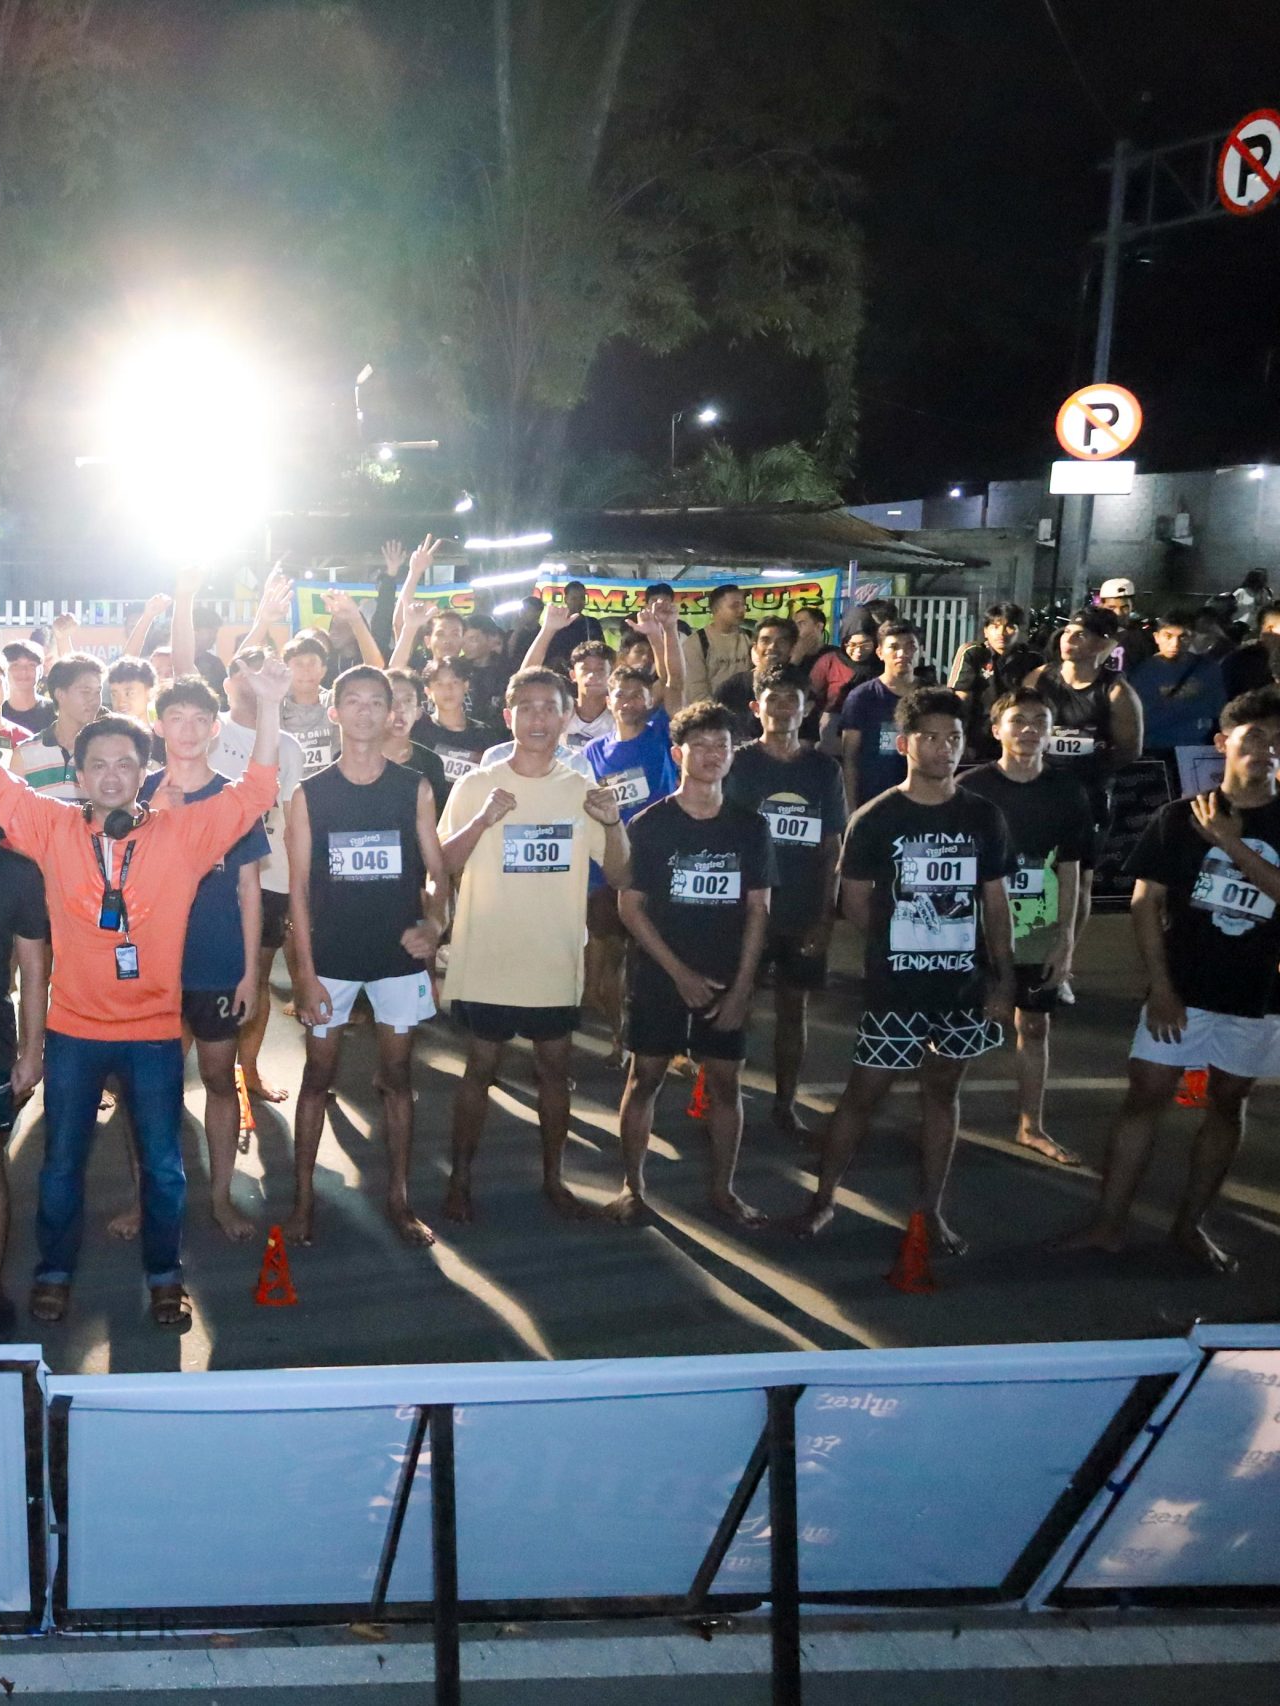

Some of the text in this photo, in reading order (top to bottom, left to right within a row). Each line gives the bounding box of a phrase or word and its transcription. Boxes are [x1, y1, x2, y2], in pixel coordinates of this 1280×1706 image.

[1056, 739, 1081, 753] 012
[777, 818, 808, 837] 007
[504, 844, 516, 852] 50
[523, 843, 559, 862] 030
[331, 852, 342, 862] 75
[351, 850, 388, 870] 046
[505, 853, 516, 863] M
[332, 863, 342, 871] M
[903, 862, 916, 871] 50
[926, 862, 961, 881] 001
[673, 875, 685, 883] 50
[903, 873, 916, 883] M
[673, 884, 684, 893] M
[692, 875, 729, 894] 002
[1222, 883, 1260, 909] 017
[887, 953, 975, 972] TENDENCIES
